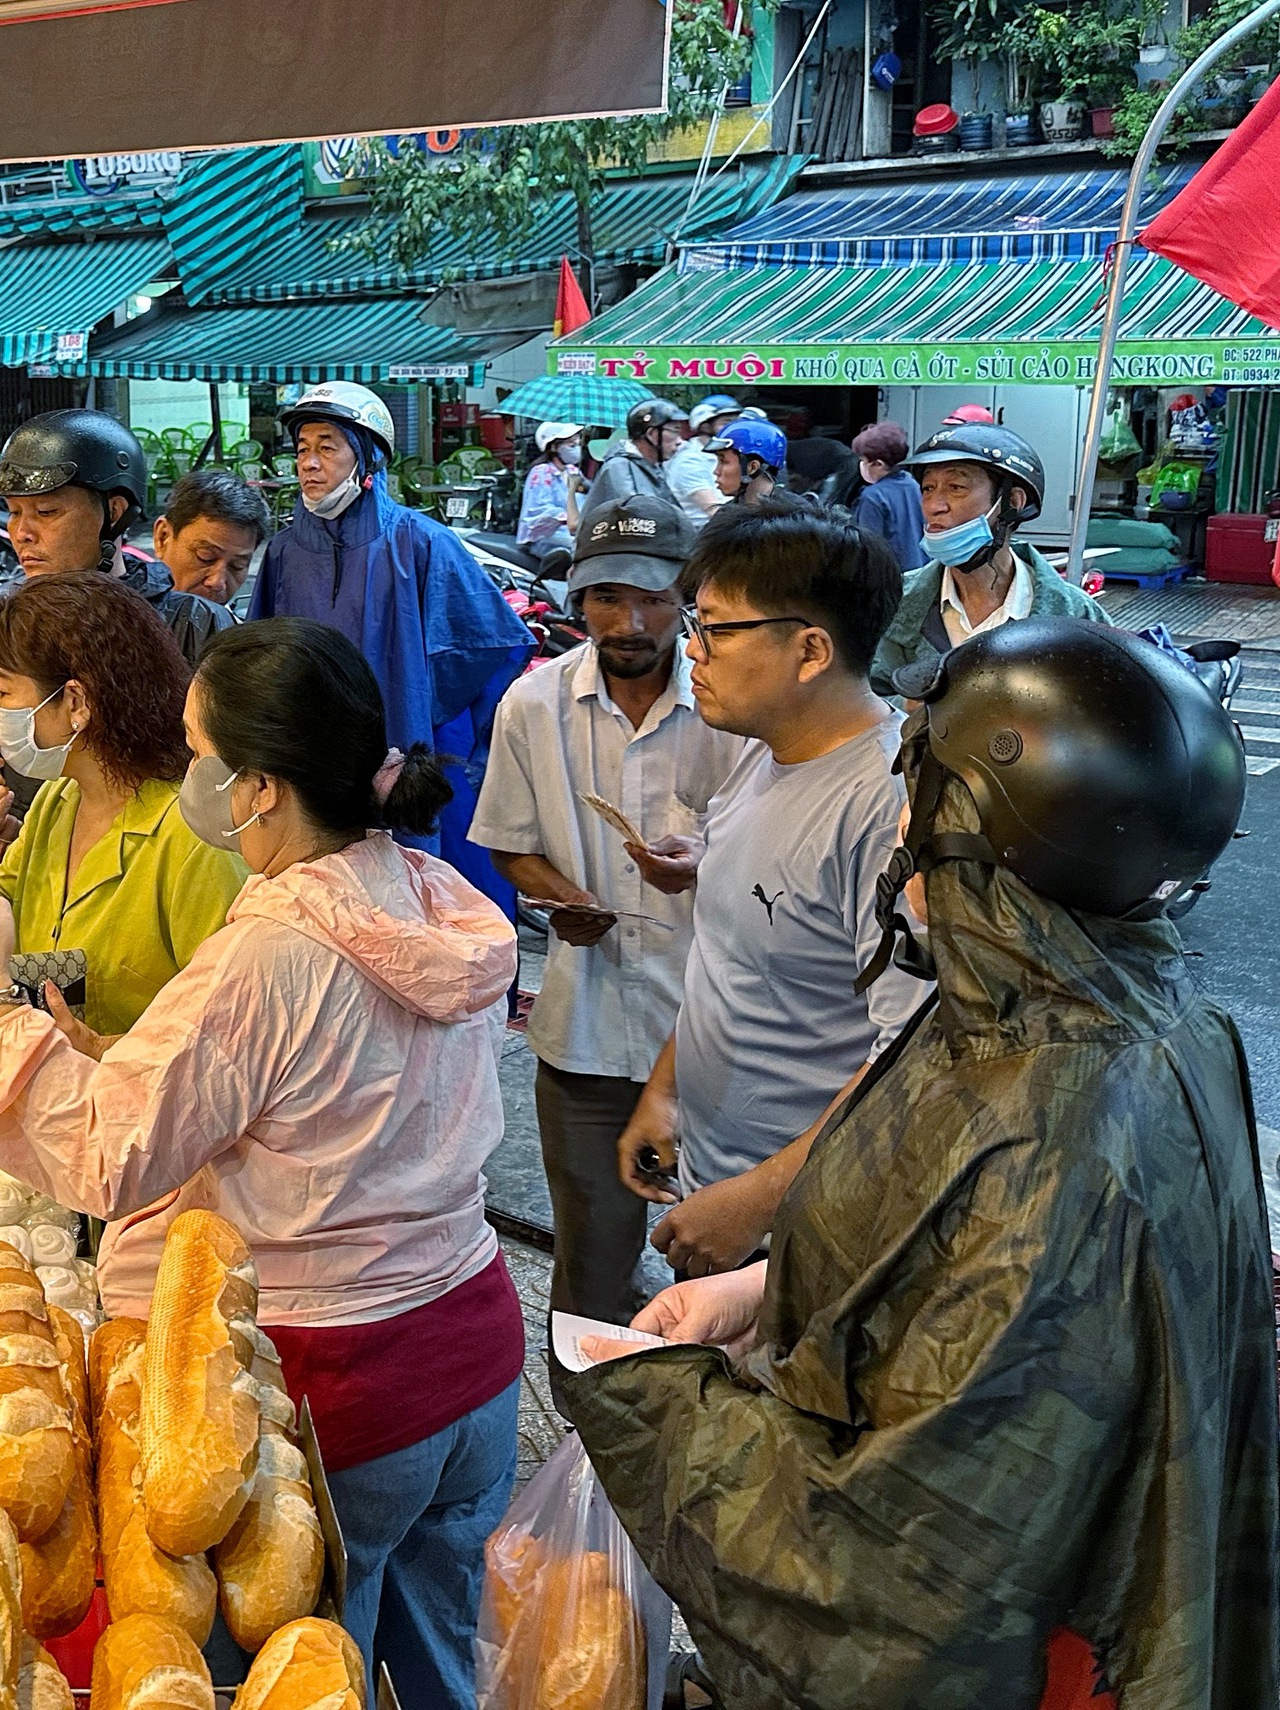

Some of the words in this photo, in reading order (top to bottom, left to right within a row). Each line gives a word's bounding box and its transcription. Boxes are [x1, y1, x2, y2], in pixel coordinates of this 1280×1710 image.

[600, 351, 654, 378] TỶ
[670, 353, 785, 382] MUỘI
[794, 351, 839, 379] KHỔ
[844, 358, 886, 382] QUA
[893, 352, 921, 379] CÀ
[928, 353, 958, 379] ỚT
[976, 350, 1015, 379] SỦI
[1021, 349, 1070, 379] CẢO
[1076, 355, 1215, 379] HNGKONG
[1243, 348, 1262, 362] 522
